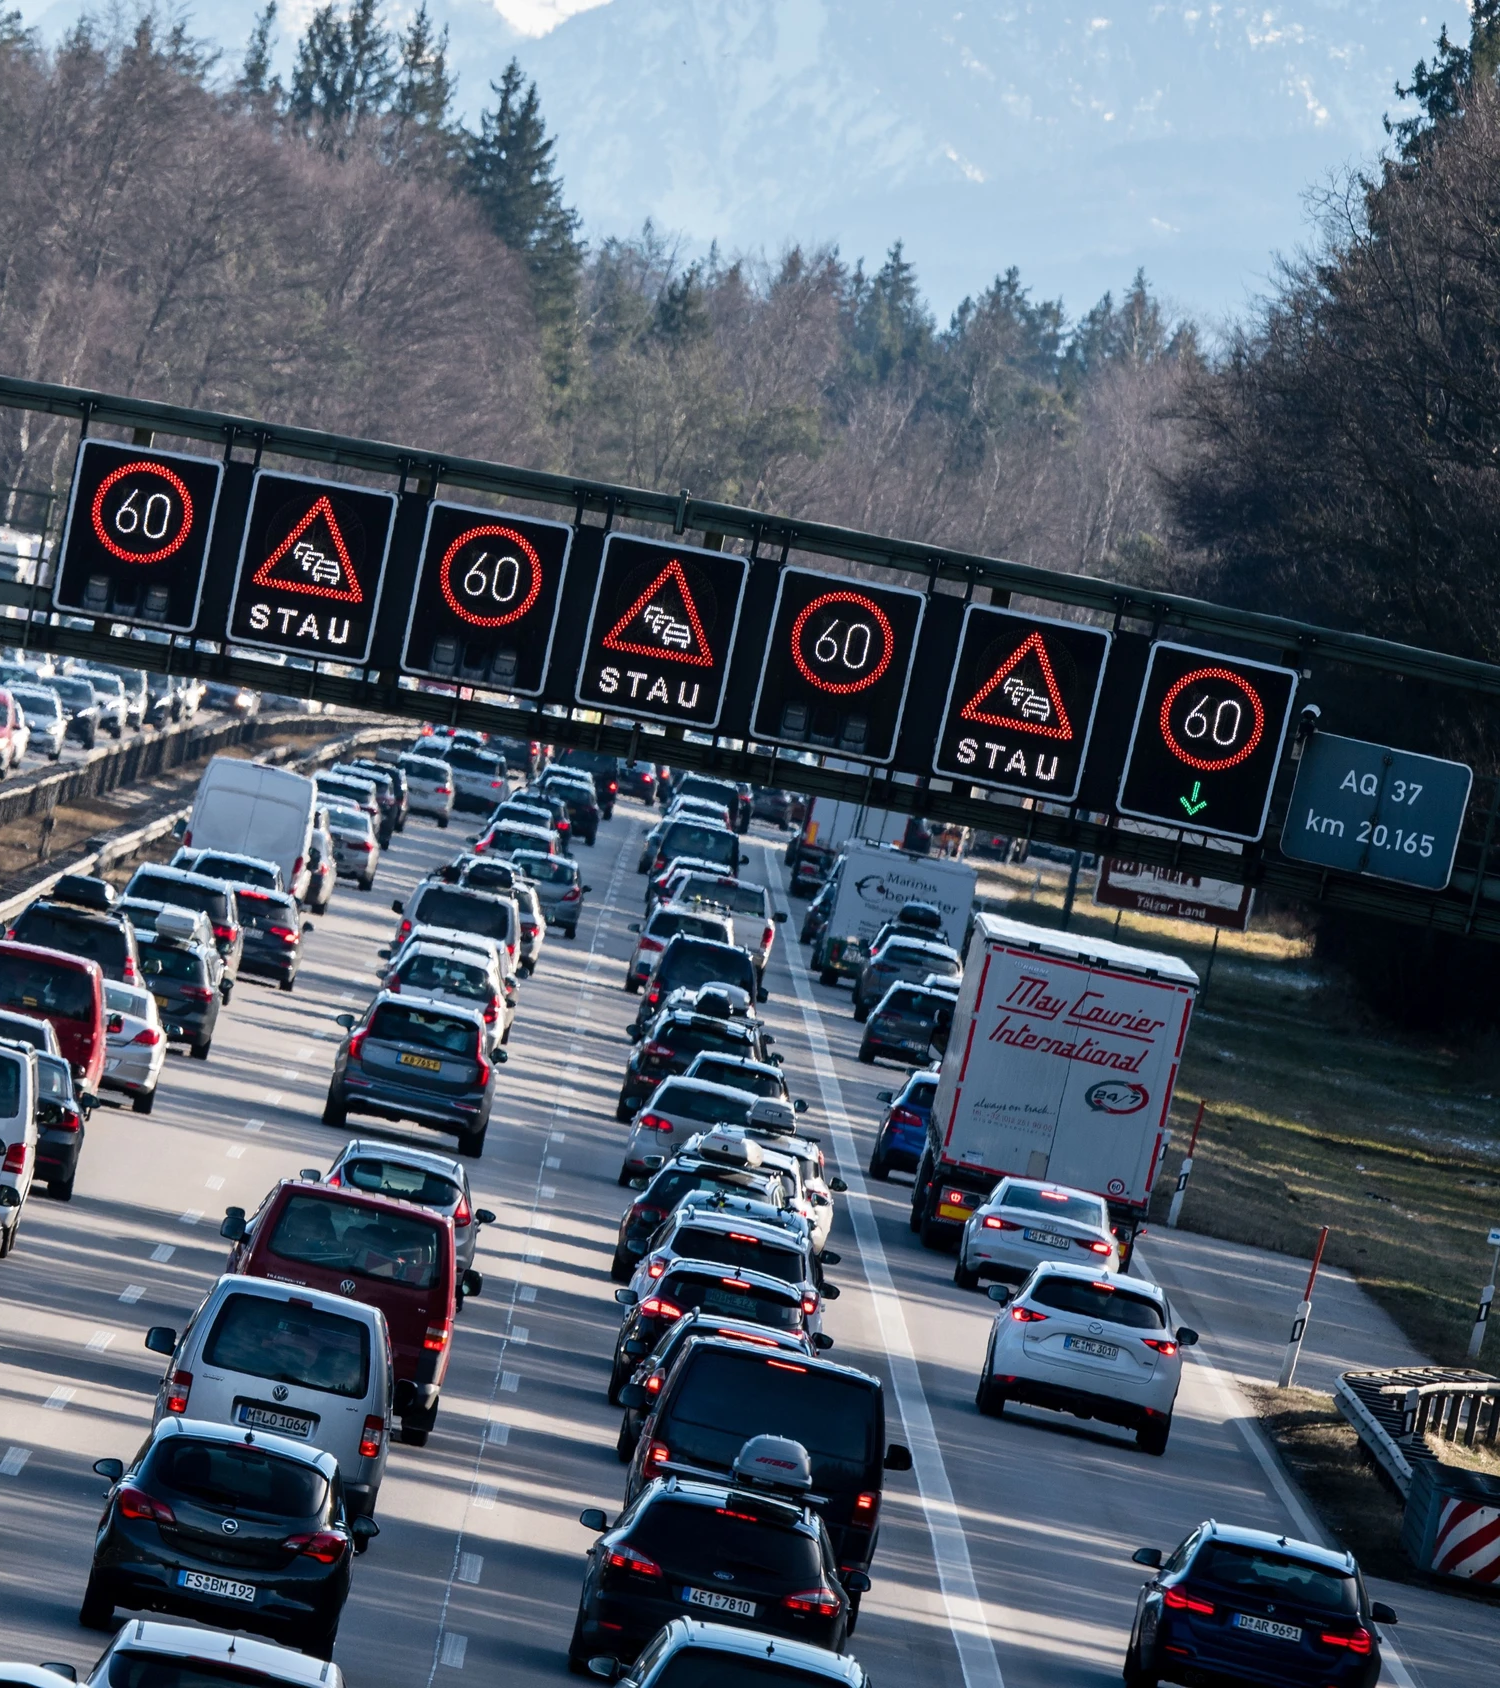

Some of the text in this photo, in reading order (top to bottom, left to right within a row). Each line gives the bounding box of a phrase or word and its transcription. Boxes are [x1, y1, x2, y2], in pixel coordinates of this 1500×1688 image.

[115, 487, 170, 540] 60
[462, 551, 520, 603] 60
[248, 602, 350, 646] STAU
[814, 618, 870, 669] 60
[598, 665, 701, 711] STAU
[1184, 695, 1241, 747] 60
[955, 736, 1060, 783] STAU
[1339, 769, 1424, 806] AQ 37
[1304, 808, 1345, 838] km
[887, 872, 938, 893] Marinus
[1136, 894, 1207, 919] Tölzer Land
[1005, 975, 1166, 1034] May Courier
[988, 1015, 1150, 1074] International
[973, 1098, 1007, 1114] always
[1008, 1104, 1021, 1112] on
[1092, 1089, 1141, 1105] 24/7
[247, 1408, 307, 1432] M LO 1064
[185, 1573, 204, 1588] FS
[210, 1579, 229, 1594] BM
[229, 1583, 254, 1600] 192
[691, 1589, 751, 1614] 4E1 7810
[1240, 1615, 1248, 1627] D
[1254, 1620, 1270, 1633] AR
[1271, 1623, 1299, 1640] 9691
